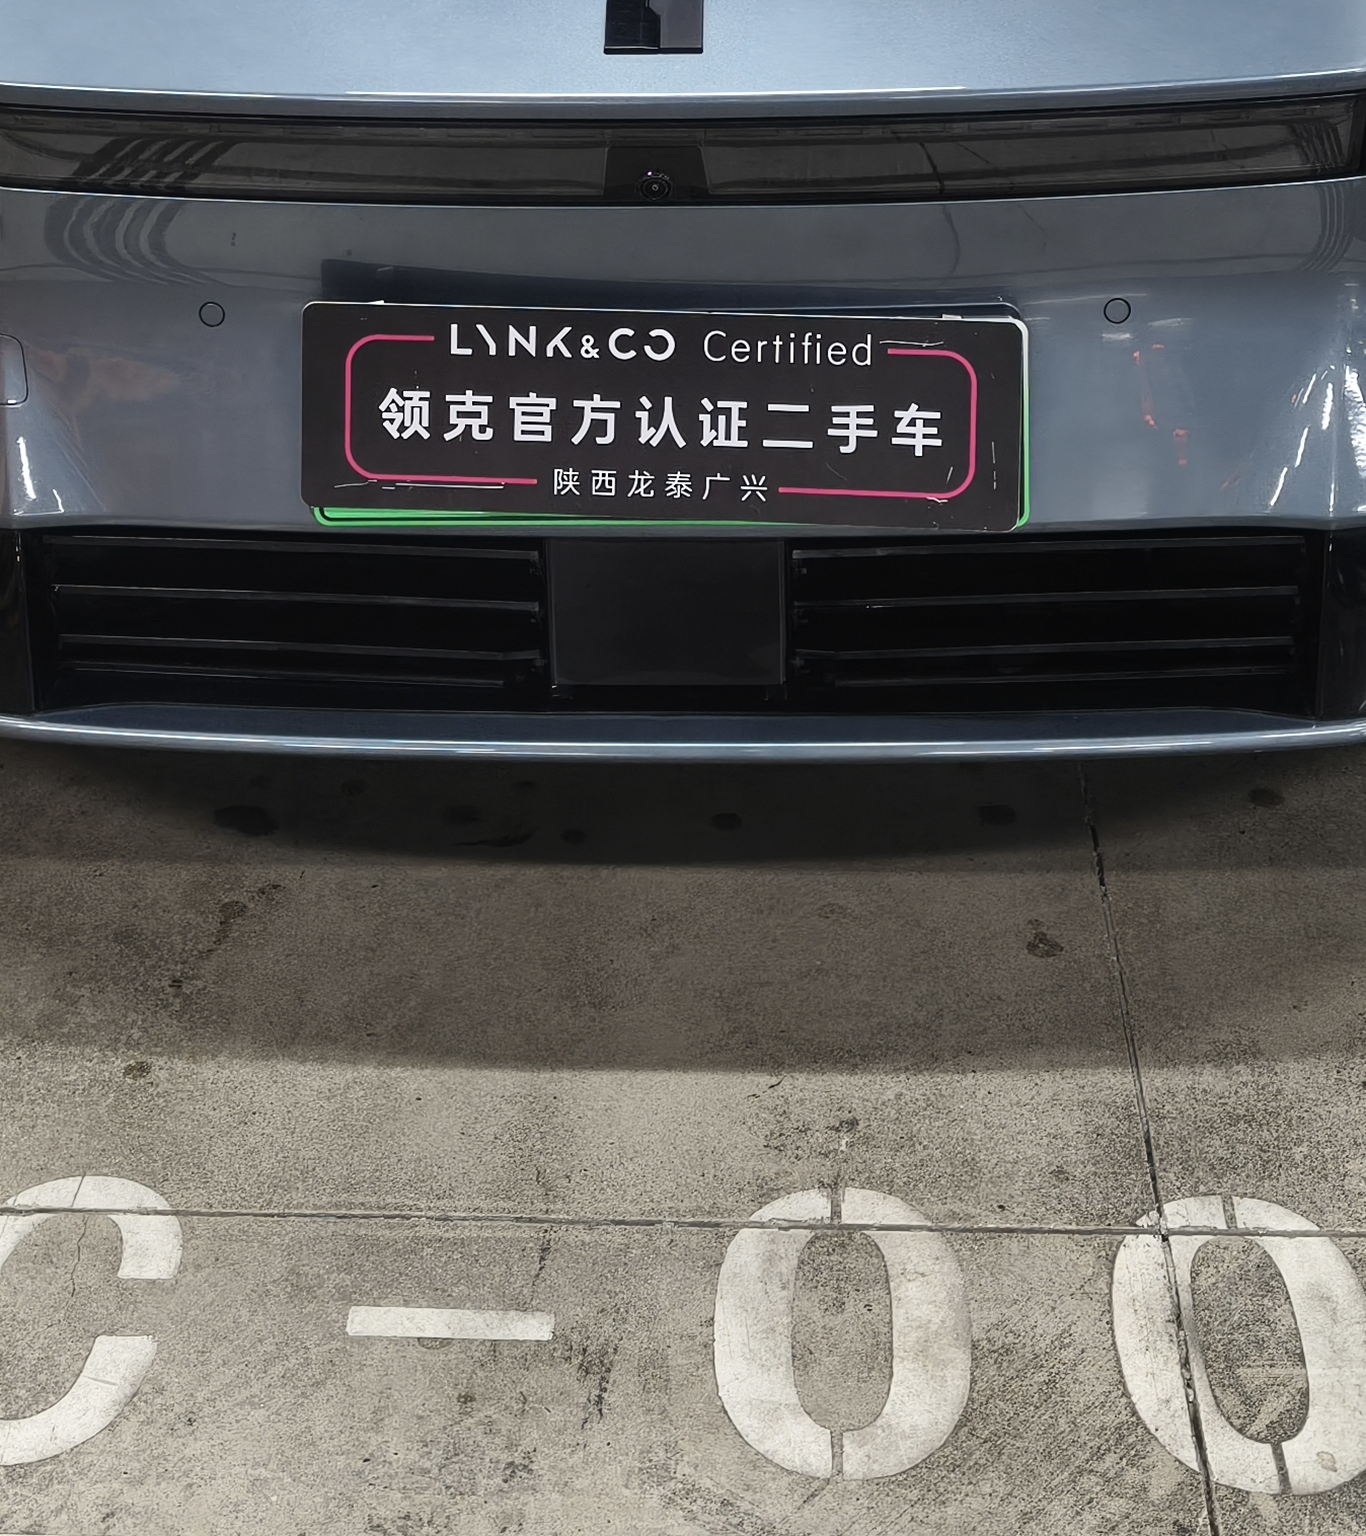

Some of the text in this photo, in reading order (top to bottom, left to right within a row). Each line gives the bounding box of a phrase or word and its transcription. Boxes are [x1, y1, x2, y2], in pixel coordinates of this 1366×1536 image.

[450, 323, 873, 367] LYNK&CO Certified
[378, 387, 944, 457] 领克官方认证二手车
[553, 467, 769, 503] 陕西龙泰广兴
